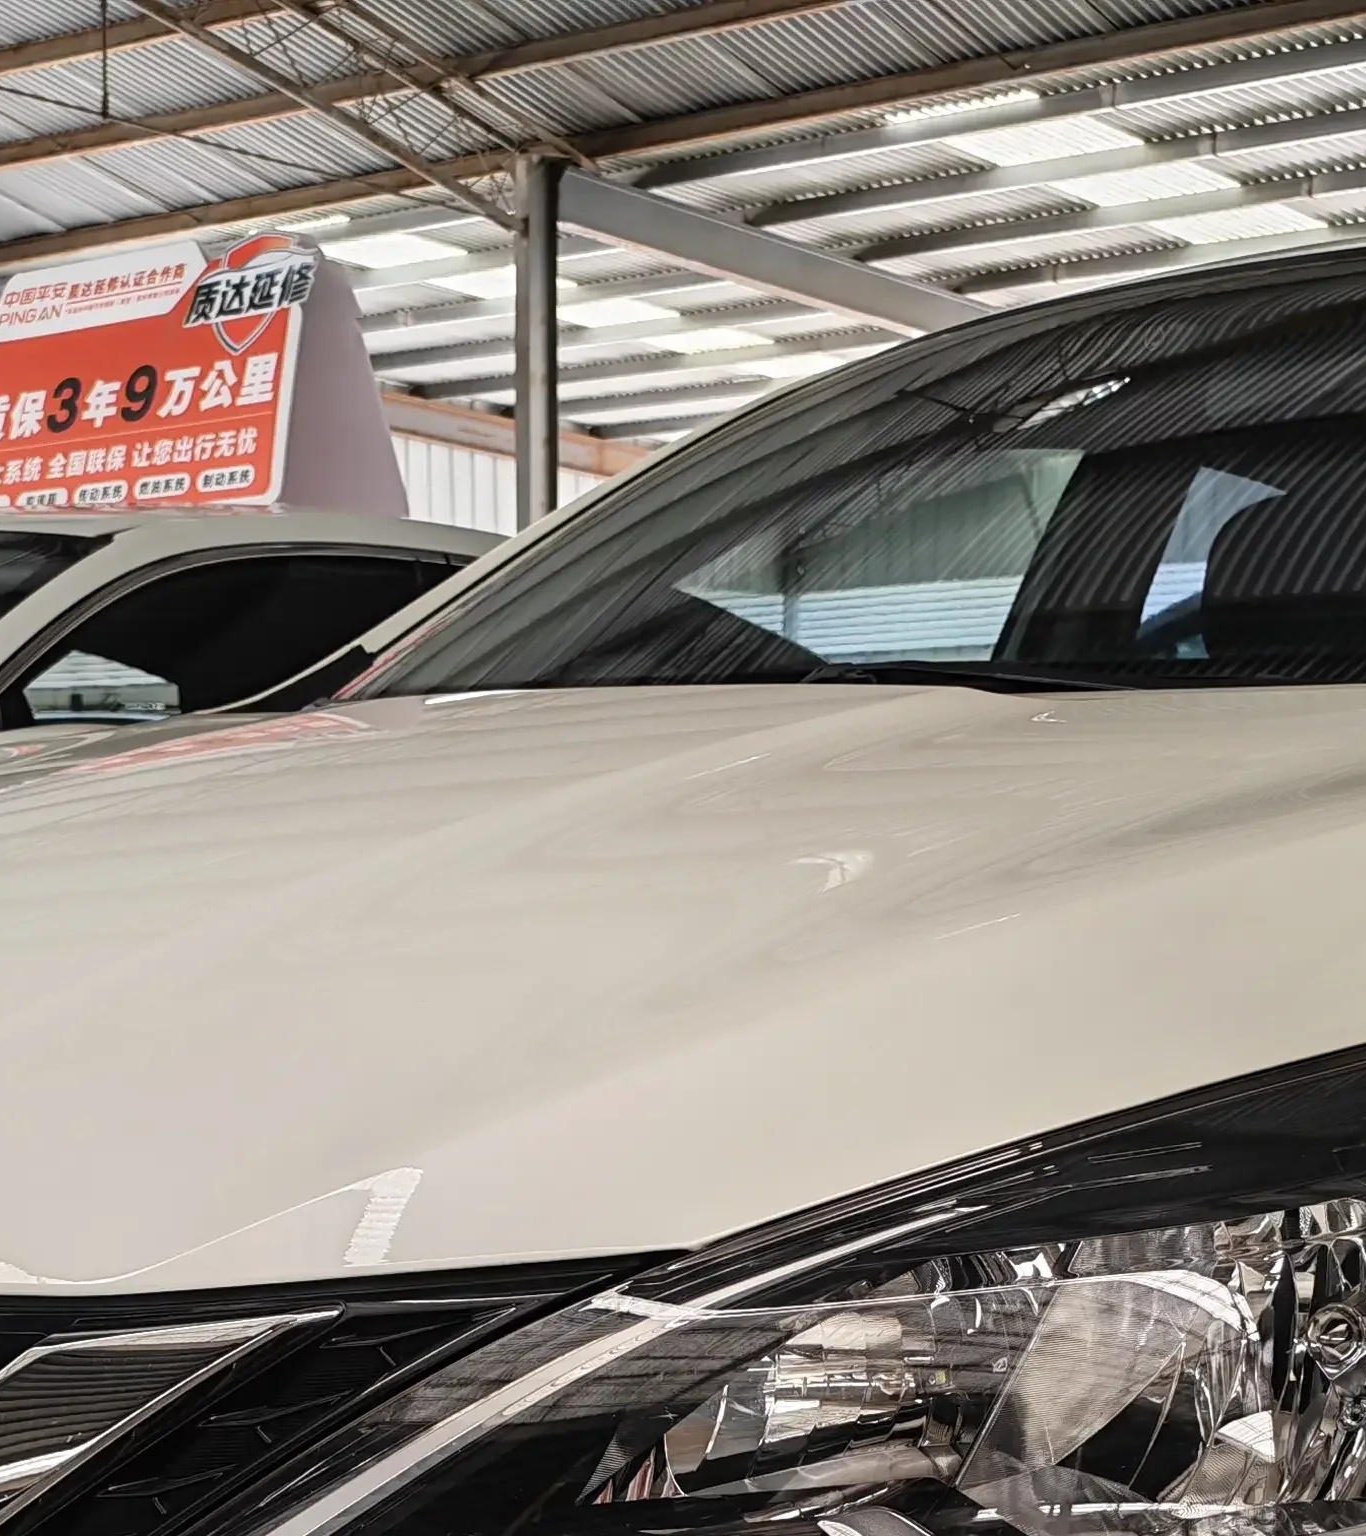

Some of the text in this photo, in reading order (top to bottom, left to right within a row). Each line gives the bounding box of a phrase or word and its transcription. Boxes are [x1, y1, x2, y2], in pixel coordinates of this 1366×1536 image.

[4, 282, 68, 308] 中国平安
[185, 263, 315, 325] 质达延修
[46, 444, 127, 480] 全国联保
[131, 426, 258, 468] 让您出行无忧
